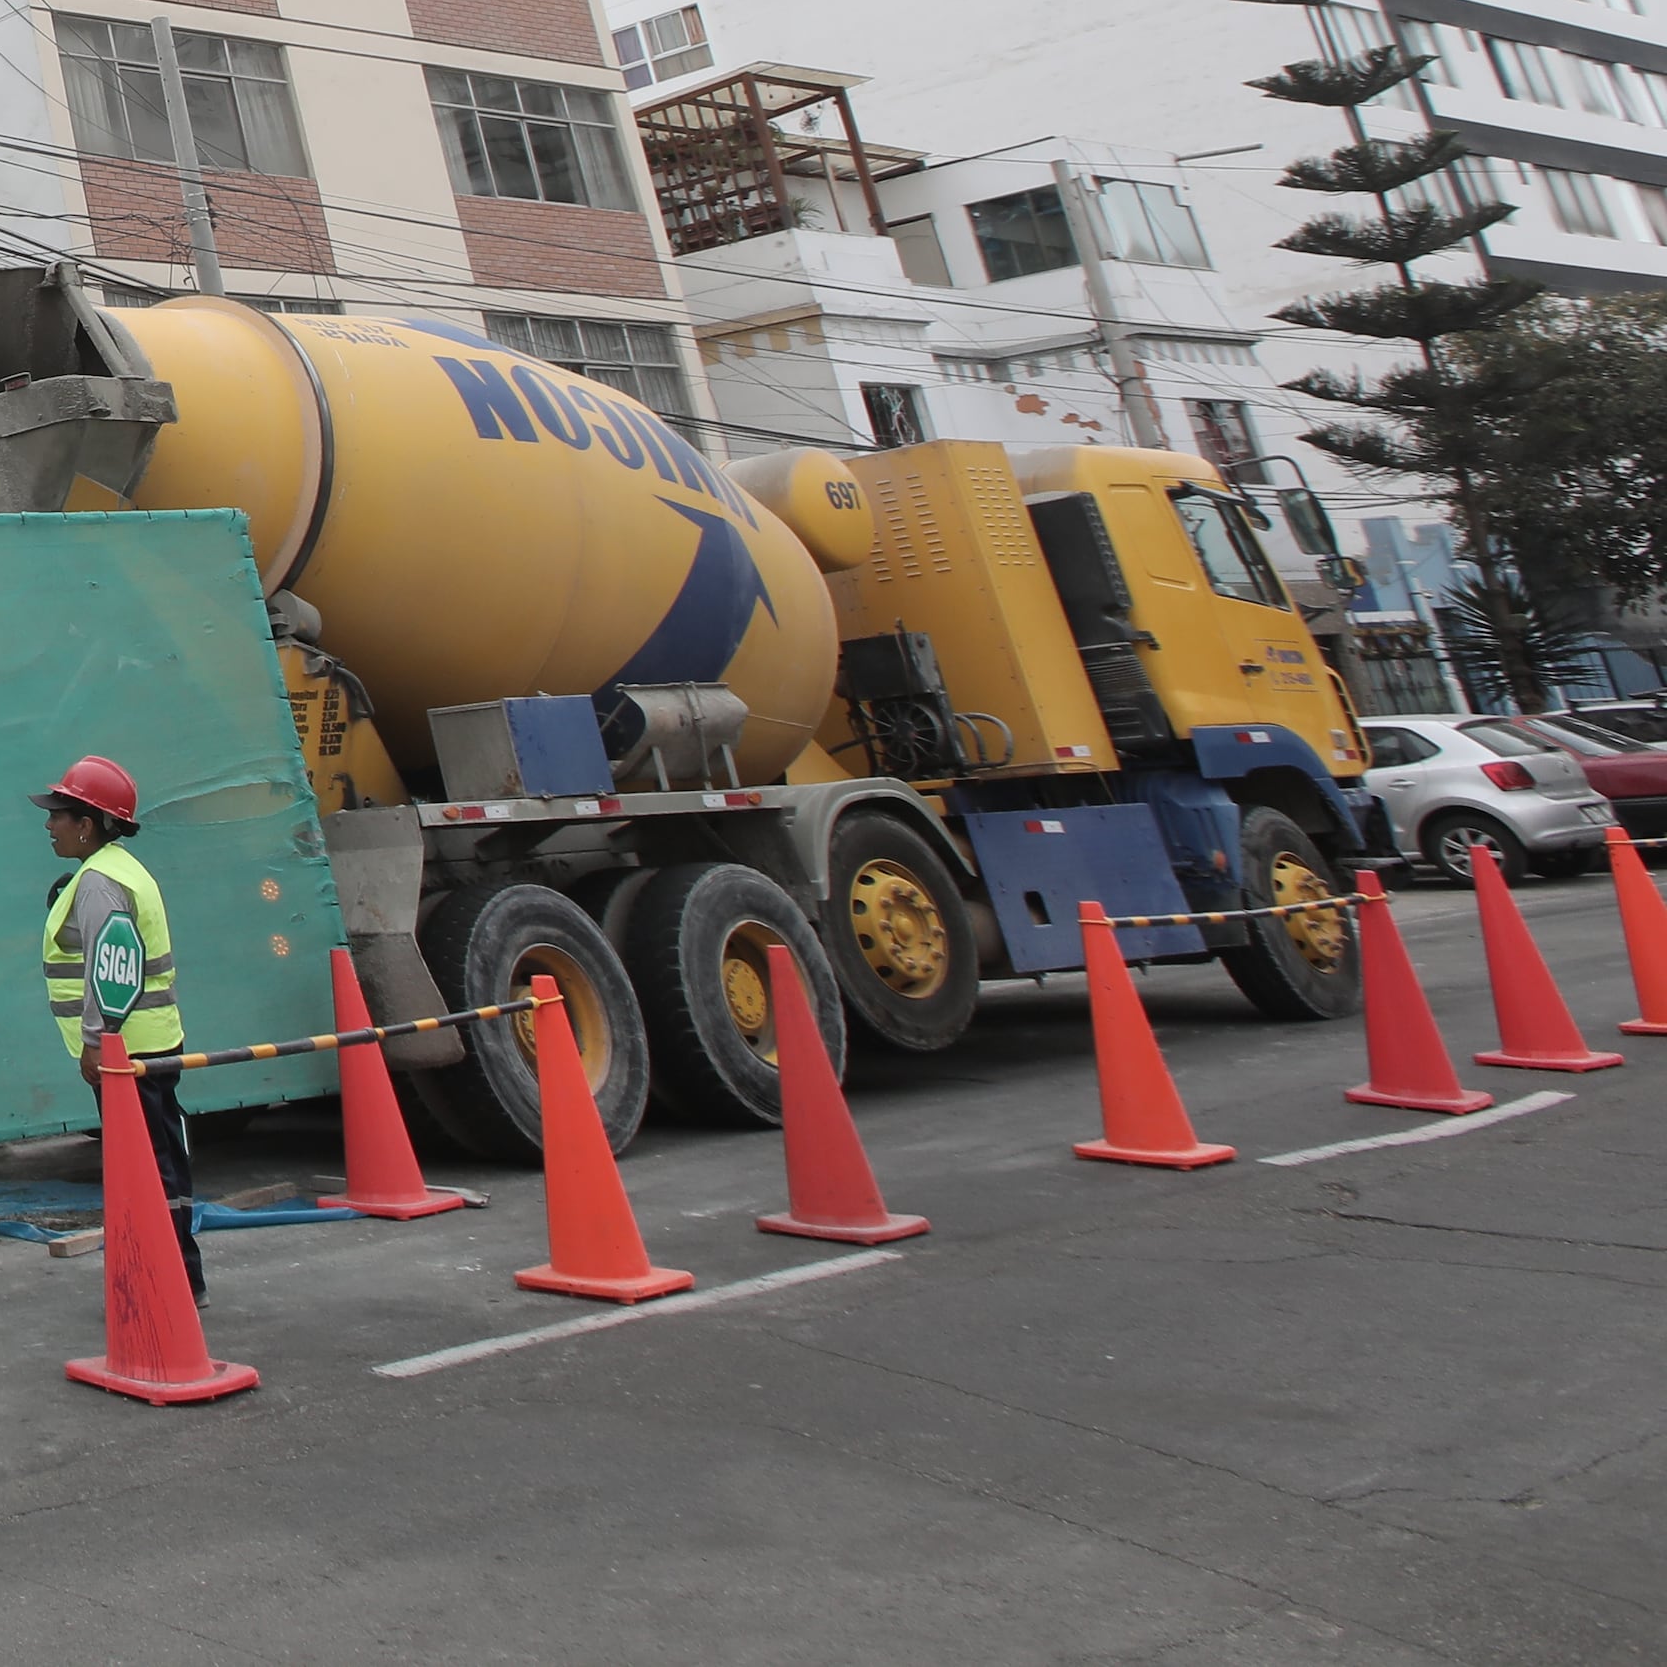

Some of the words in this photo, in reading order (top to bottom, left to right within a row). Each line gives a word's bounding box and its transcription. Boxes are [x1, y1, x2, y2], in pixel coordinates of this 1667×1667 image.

[432, 355, 760, 532] UNICON
[825, 481, 861, 511] 697
[98, 942, 137, 987] SIGA
